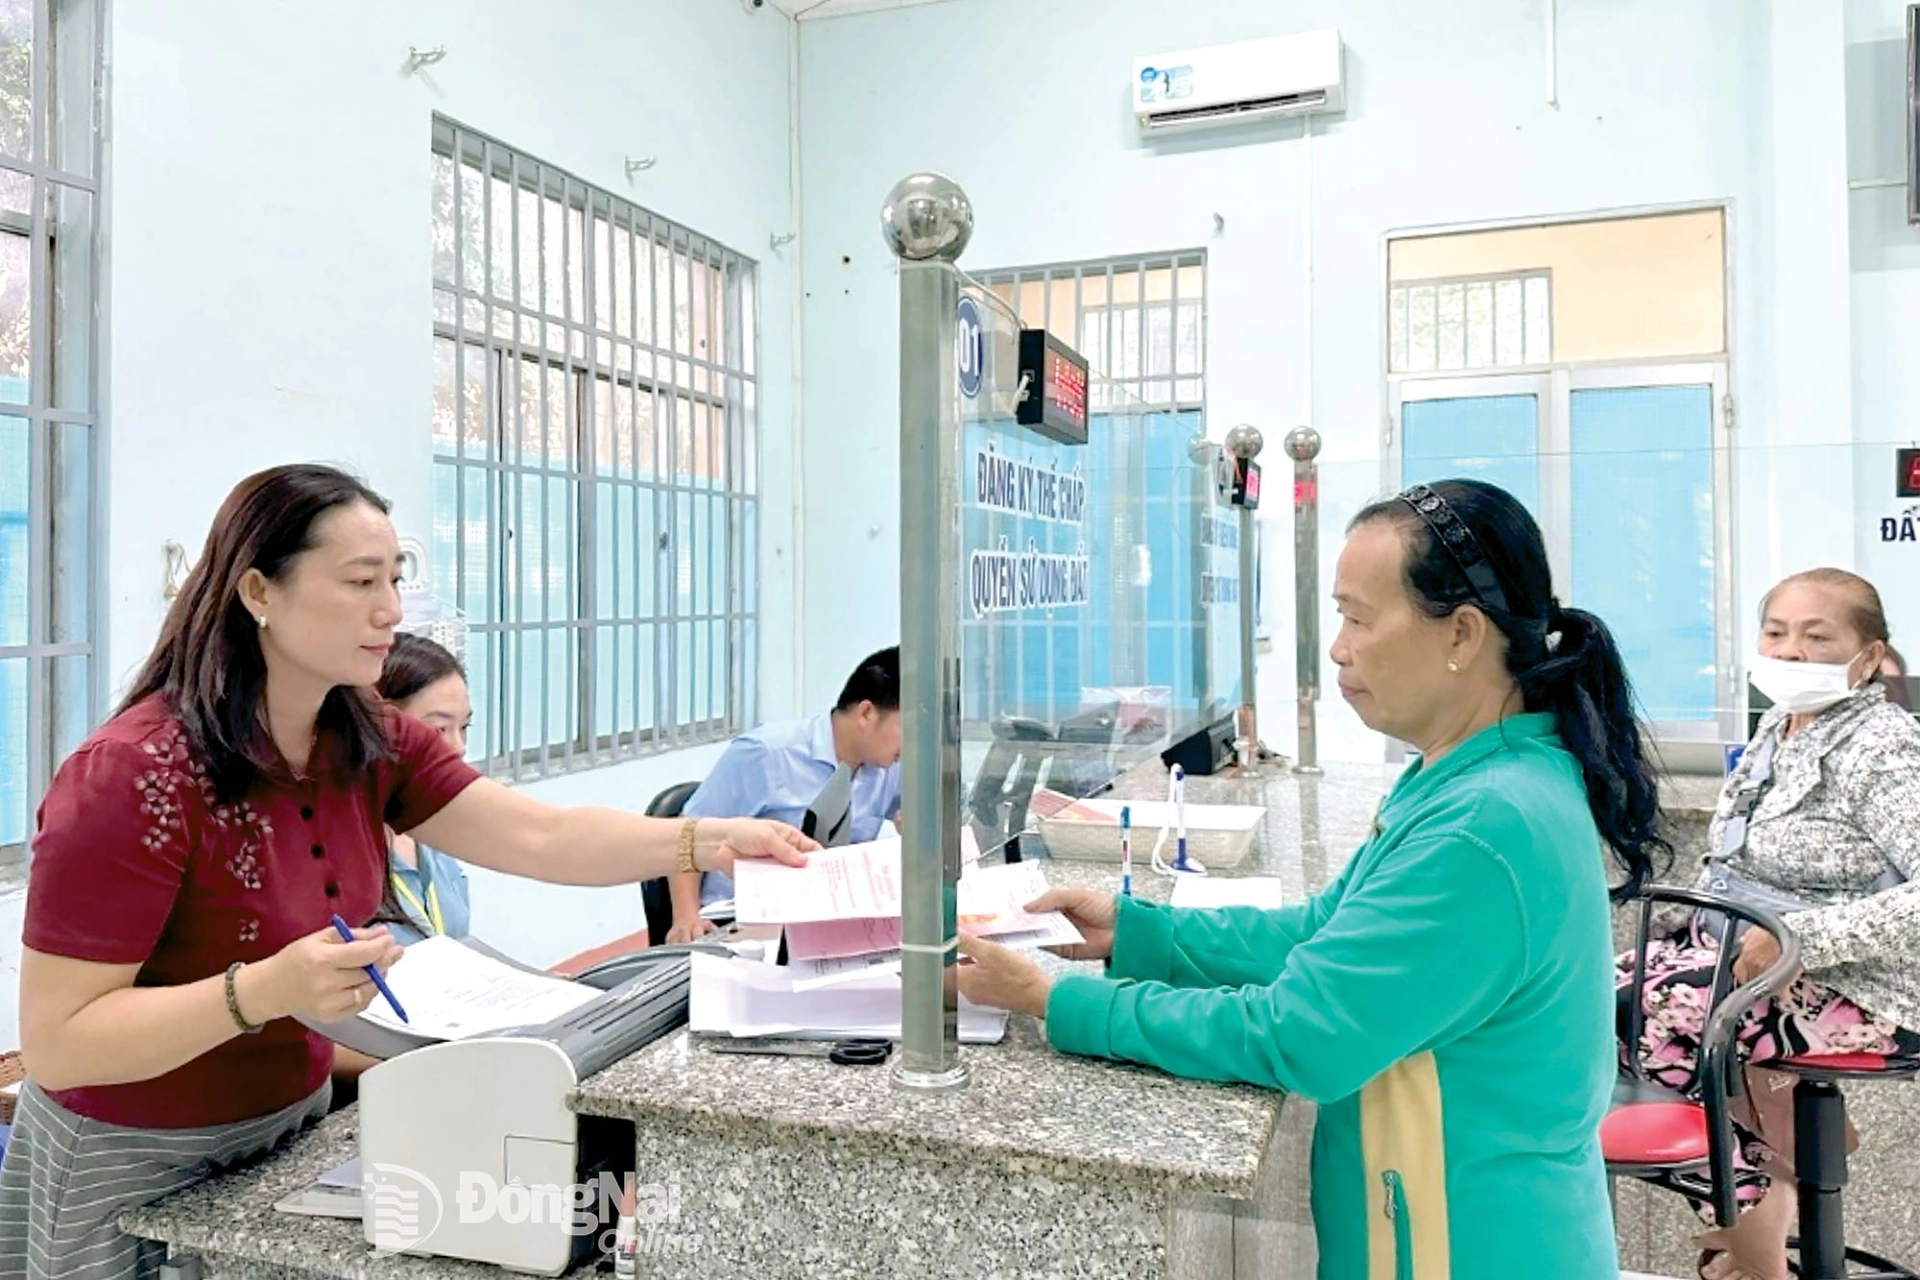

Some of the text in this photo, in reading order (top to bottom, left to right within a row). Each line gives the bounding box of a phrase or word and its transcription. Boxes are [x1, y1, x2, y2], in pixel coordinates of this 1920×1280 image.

[959, 317, 979, 376] 01
[977, 442, 1015, 509] ĐĂNG
[1018, 455, 1034, 513] KÝ
[1037, 457, 1058, 519] THẾ
